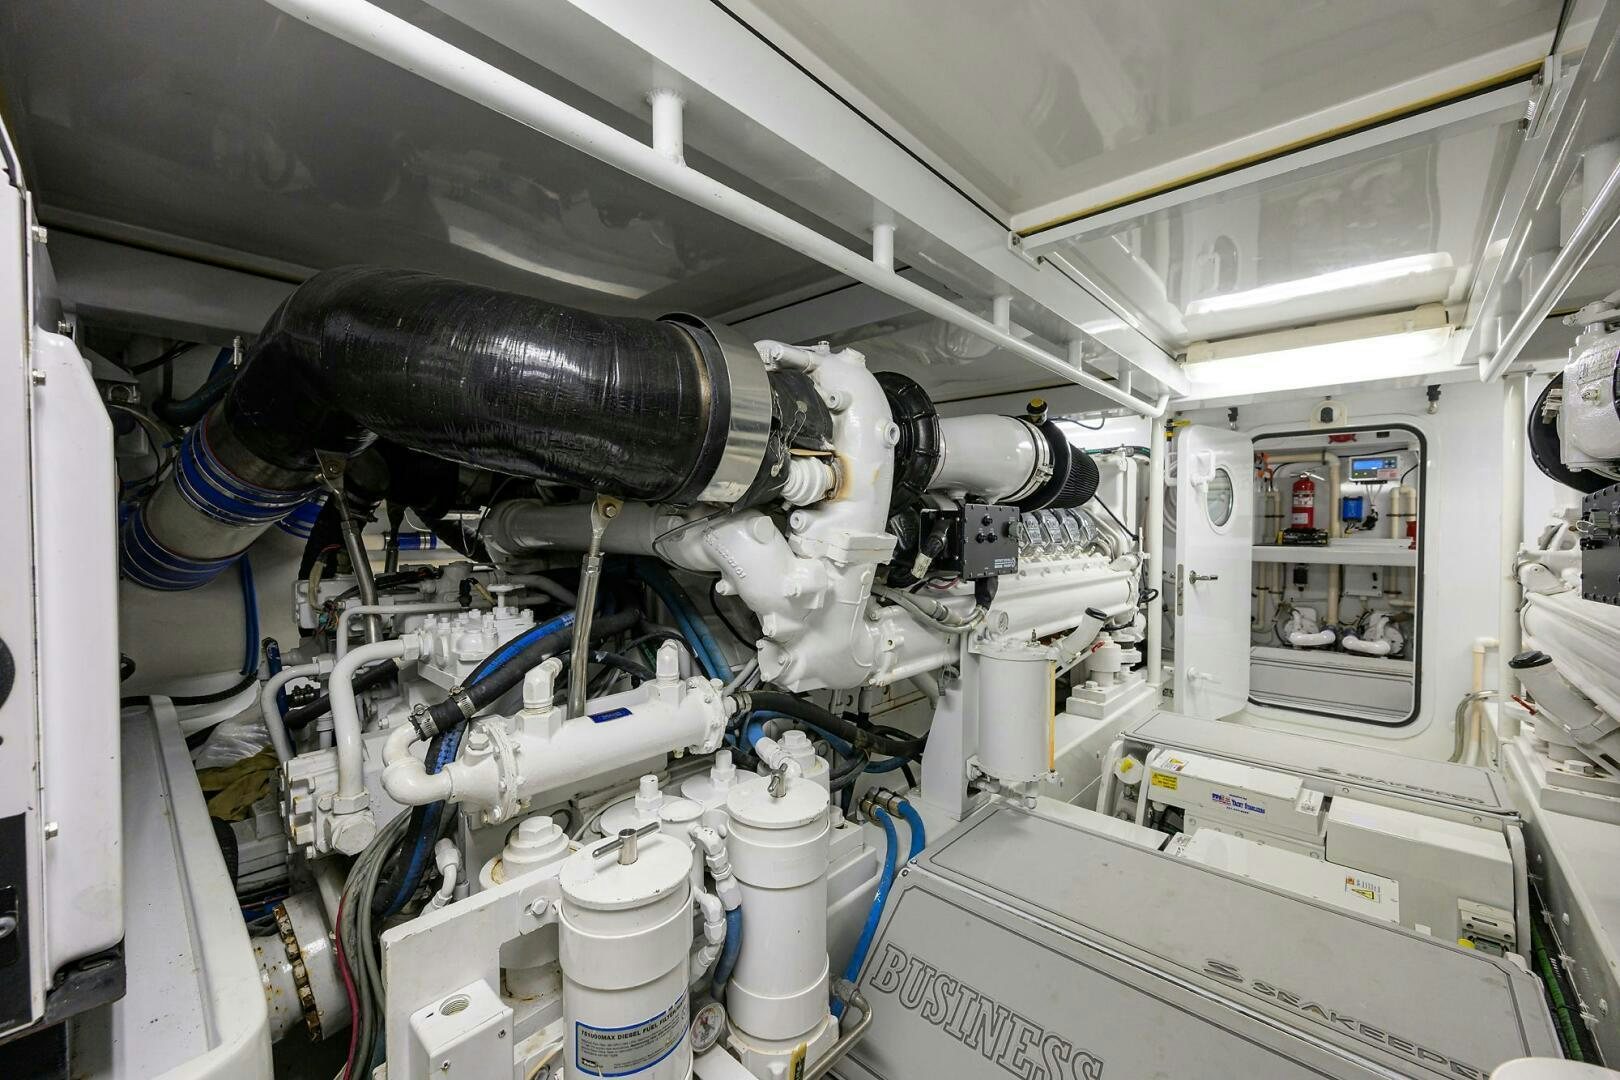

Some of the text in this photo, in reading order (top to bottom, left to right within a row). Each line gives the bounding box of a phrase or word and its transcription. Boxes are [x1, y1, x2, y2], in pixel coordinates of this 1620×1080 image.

[617, 1030, 641, 1040] DIESEL
[642, 1023, 658, 1033] FUEL
[870, 943, 1104, 1080] BUSINESS
[1253, 981, 1490, 1080] SEAKEEPE
